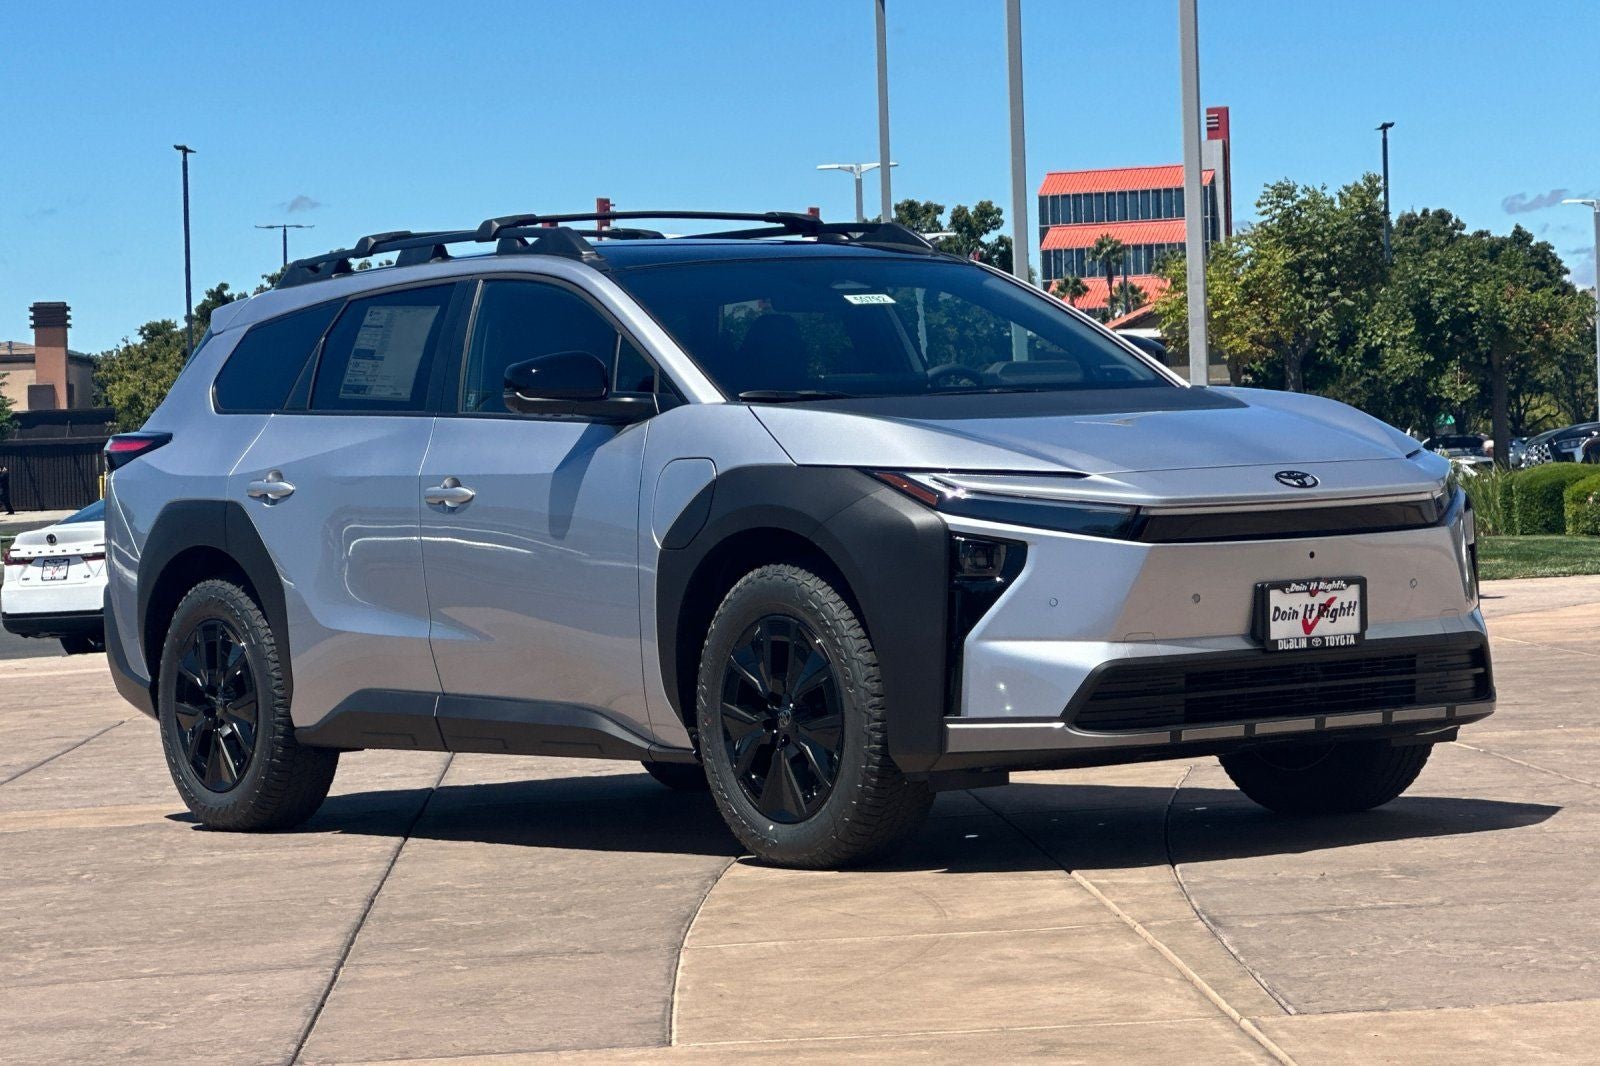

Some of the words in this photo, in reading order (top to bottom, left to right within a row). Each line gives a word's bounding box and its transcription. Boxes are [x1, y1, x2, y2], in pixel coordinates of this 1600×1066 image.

[1310, 582, 1318, 590] It
[1303, 603, 1316, 619] It
[1318, 601, 1358, 623] Right!
[1278, 638, 1307, 650] DUBLIN
[1325, 634, 1355, 647] TOYOTA
